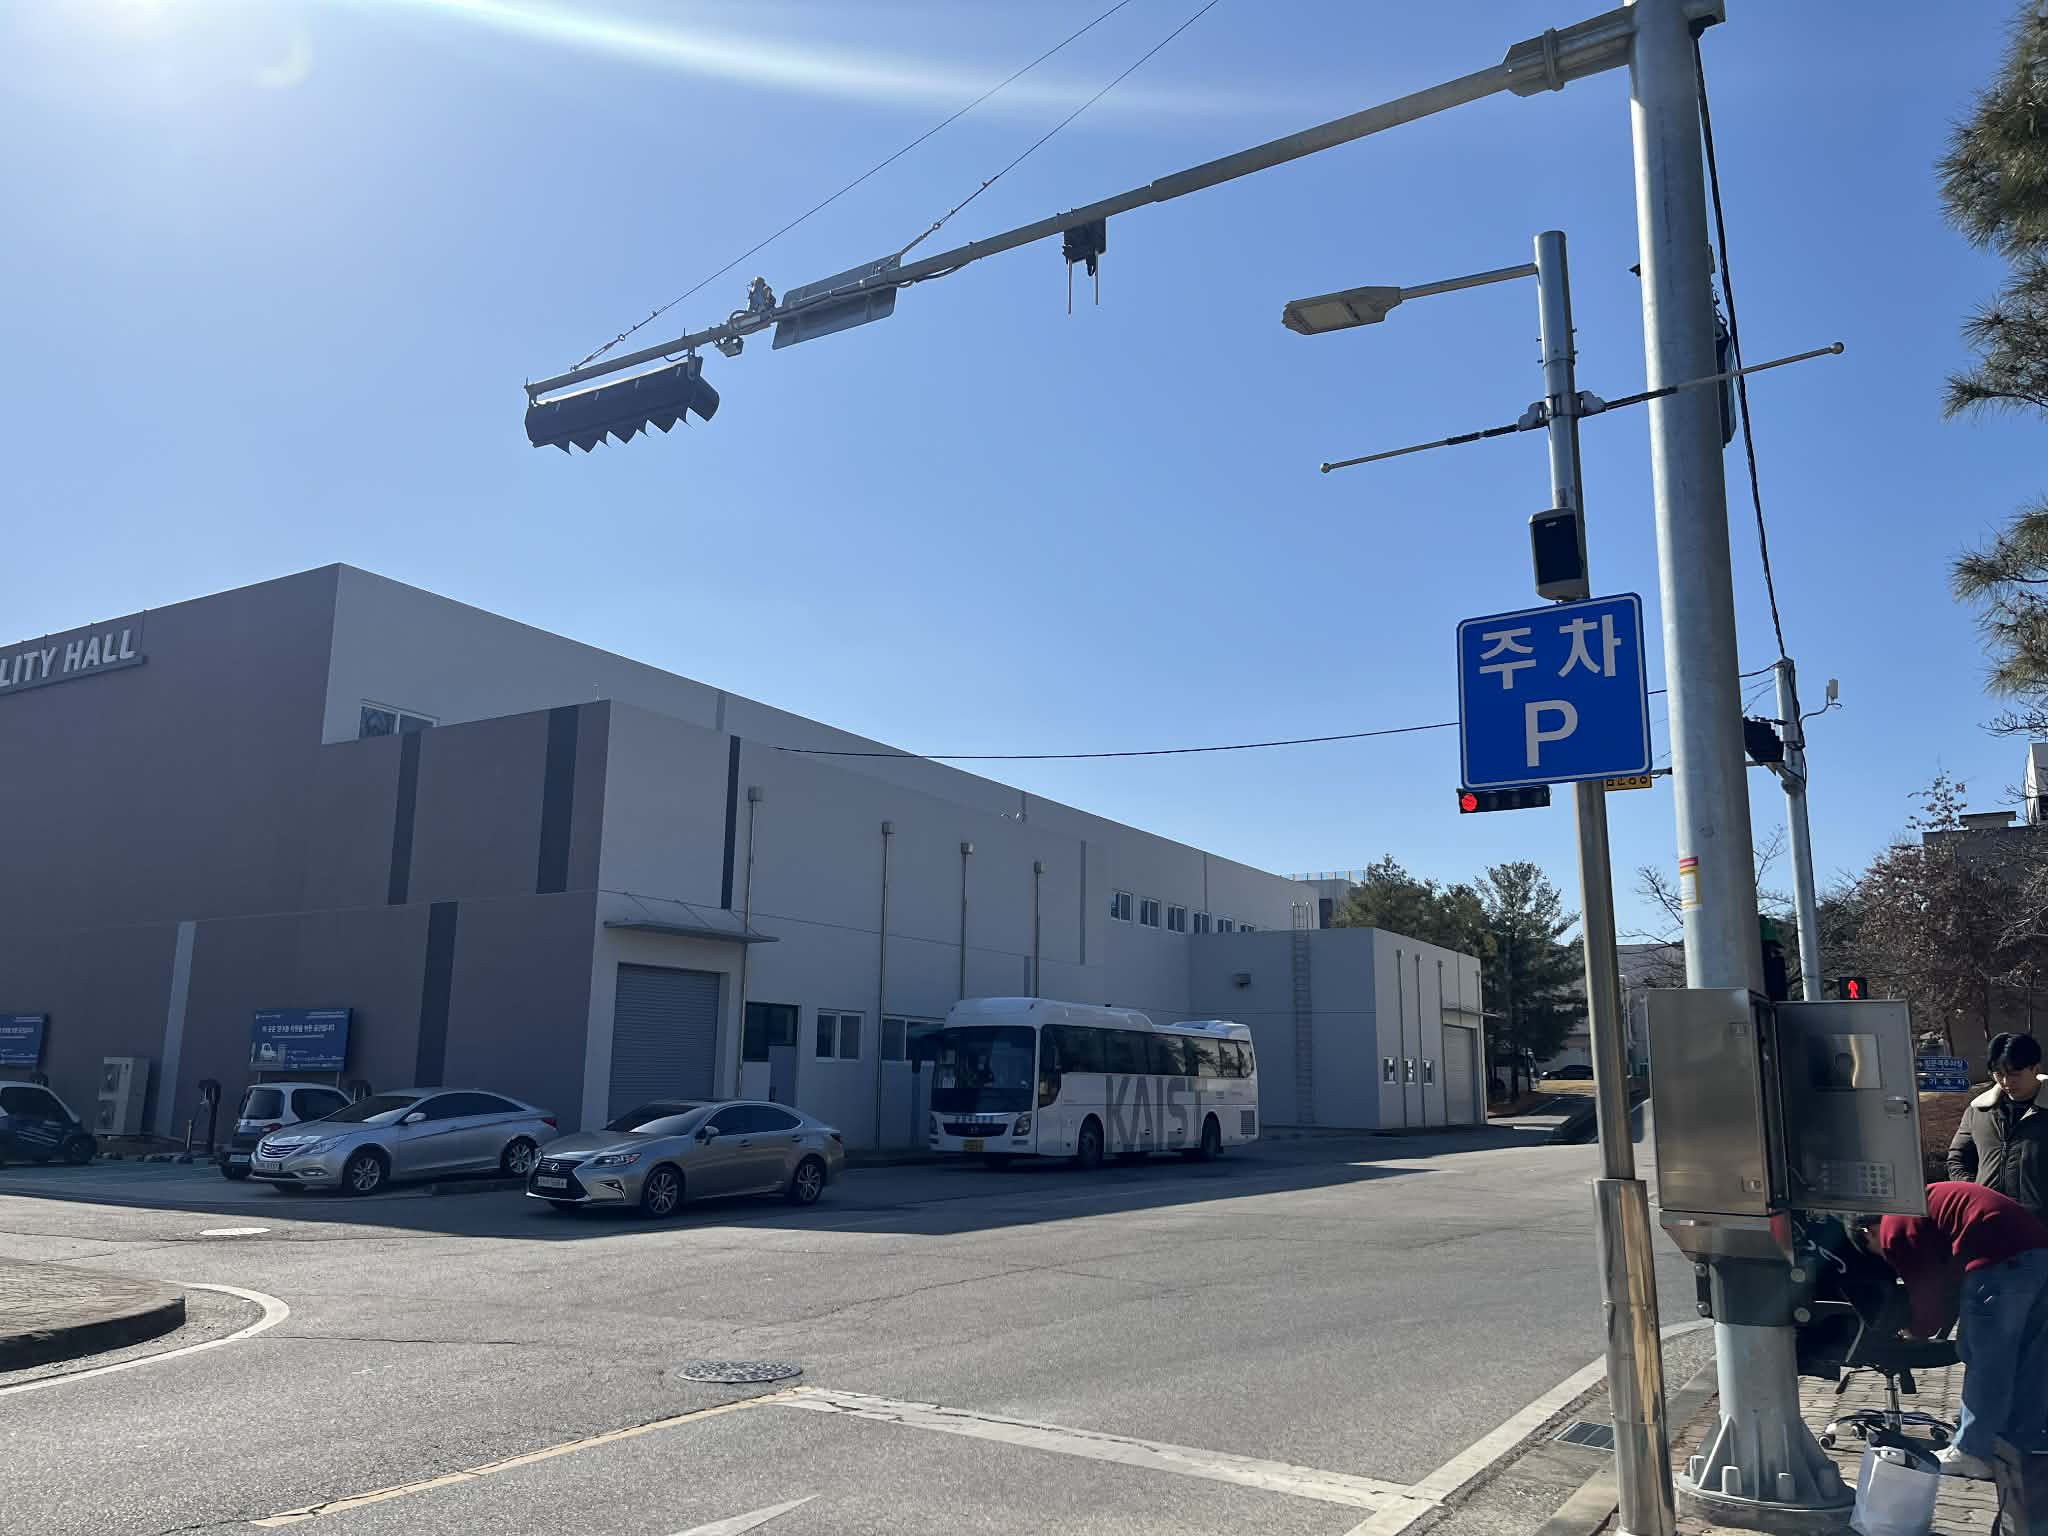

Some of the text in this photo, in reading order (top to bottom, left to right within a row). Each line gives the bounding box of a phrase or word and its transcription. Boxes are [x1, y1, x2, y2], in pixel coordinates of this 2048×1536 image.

[63, 629, 137, 673] HALL
[1524, 699, 1579, 768] P
[1104, 1075, 1208, 1153] KAIST
